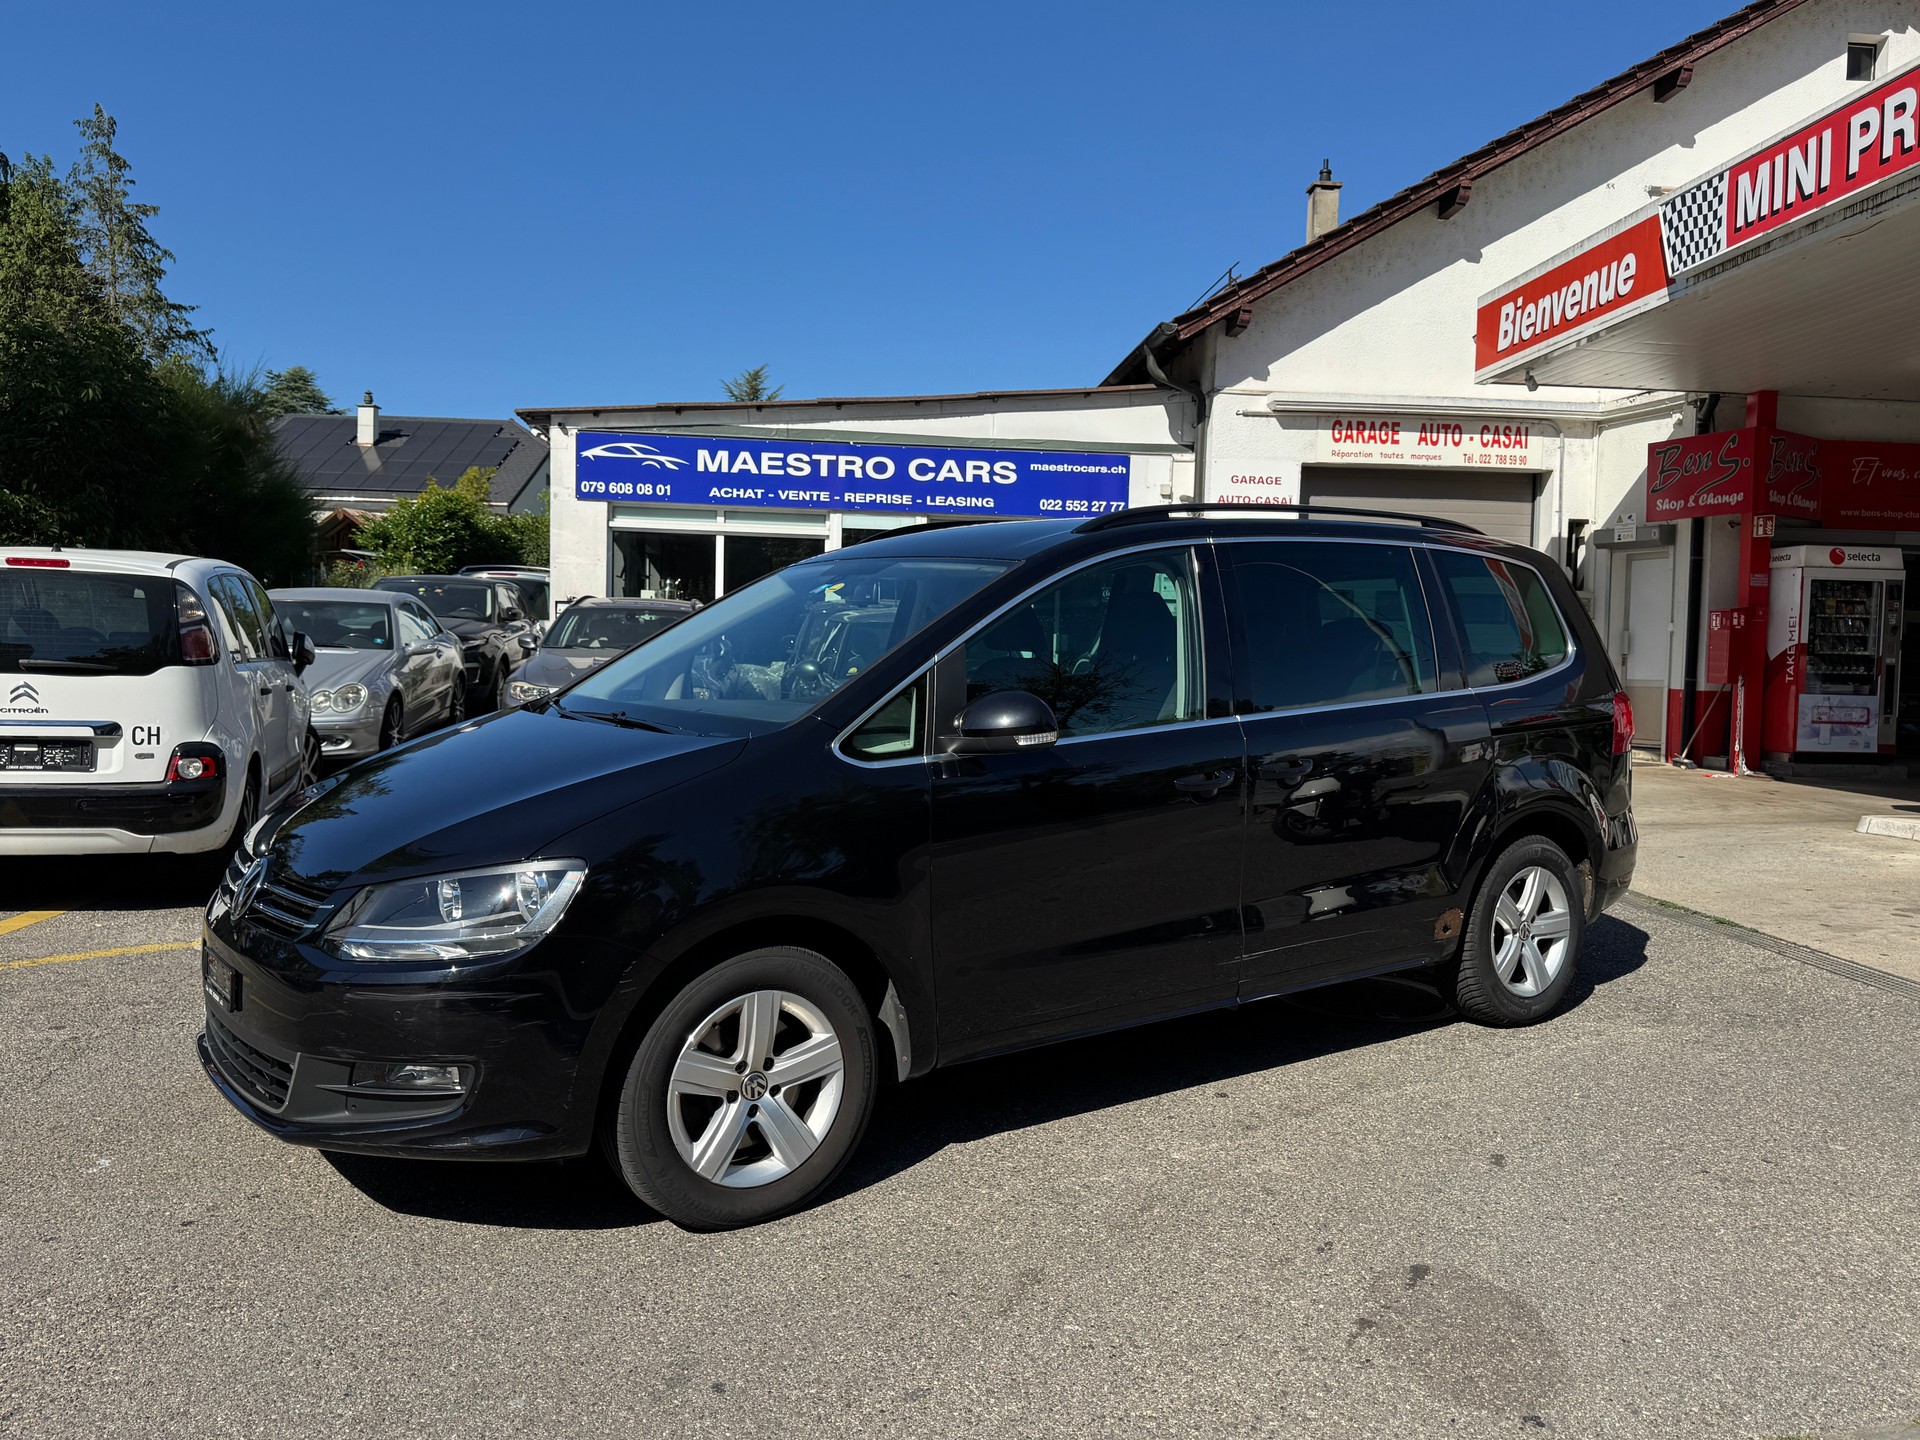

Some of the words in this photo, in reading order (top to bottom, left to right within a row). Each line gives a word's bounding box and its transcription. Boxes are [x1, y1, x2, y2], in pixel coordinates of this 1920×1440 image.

[1736, 127, 1832, 230] MINI
[1848, 86, 1918, 177] PR
[1497, 252, 1637, 353] Bienvenue
[1331, 419, 1401, 445] GARAGE
[1417, 422, 1463, 448] AUTO
[1480, 424, 1529, 450] CASAI
[1331, 449, 1373, 459] Réparation
[1380, 452, 1404, 460] toutes
[1411, 453, 1442, 462] marques
[1495, 454, 1507, 465] 788
[1509, 455, 1517, 466] 59
[1518, 455, 1528, 466] 90
[1765, 435, 1802, 484] Ben
[696, 449, 896, 480] MAESTRO
[907, 458, 1018, 485] CARS
[1030, 463, 1127, 474] maestrocars.ch
[1649, 443, 1713, 495] Ben
[580, 481, 606, 493] 079
[608, 482, 634, 494] 608
[636, 483, 653, 495] 08
[655, 484, 671, 496] 01
[1230, 475, 1282, 486] GARAGE
[709, 487, 765, 499] ACHAT
[778, 490, 831, 502] VENTE
[844, 492, 913, 505] REPRISE
[926, 496, 995, 508] LEASING
[1039, 499, 1063, 511] 022
[1065, 500, 1089, 512] 552
[1091, 501, 1107, 512] 27
[1110, 501, 1126, 513] 77
[1655, 498, 1684, 512] Shop
[1687, 495, 1697, 508] &
[1698, 491, 1745, 506] Change
[1768, 489, 1786, 506] Shop
[1792, 496, 1818, 512] Change
[1771, 553, 1792, 563] selecta
[1846, 550, 1881, 562] selecta
[1788, 616, 1798, 642] ME!
[1785, 645, 1797, 684] TAKE
[131, 725, 161, 746] CH
